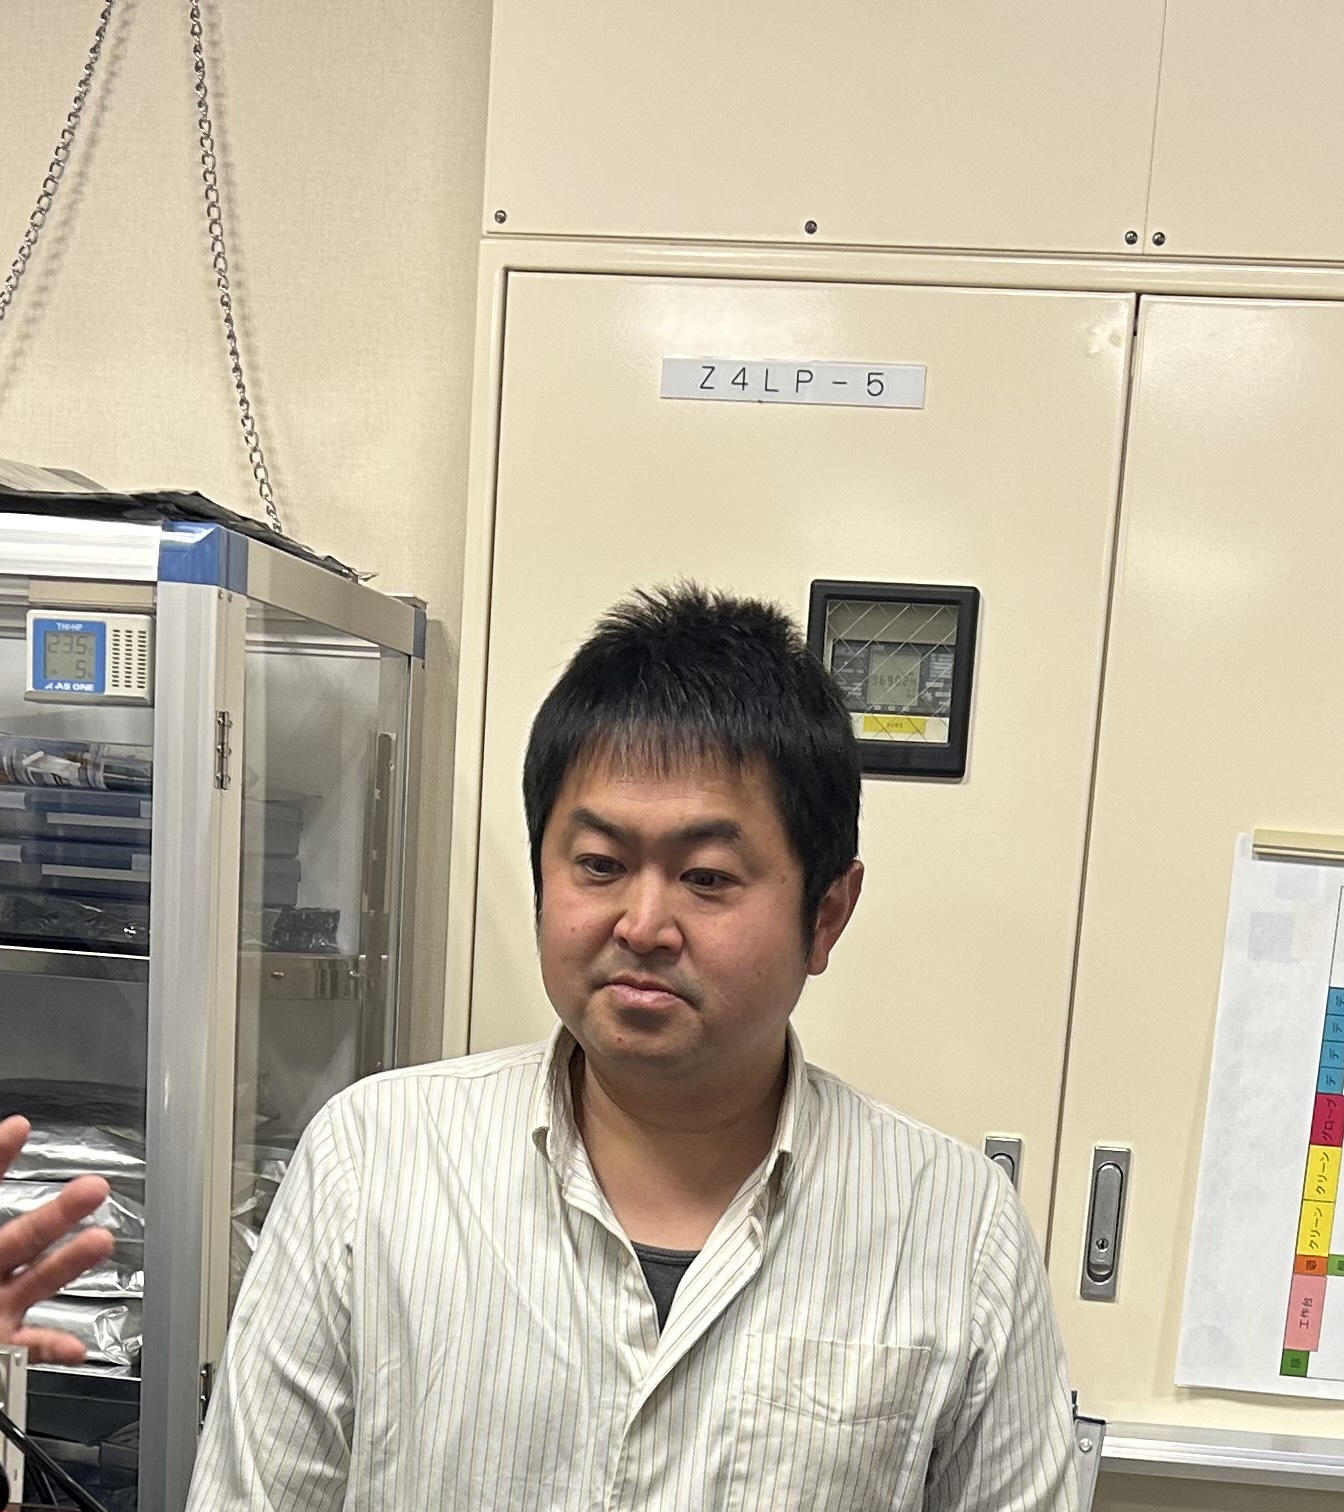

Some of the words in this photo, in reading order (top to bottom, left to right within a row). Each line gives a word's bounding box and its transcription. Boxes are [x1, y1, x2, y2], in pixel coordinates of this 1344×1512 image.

[699, 365, 885, 397] Z4LP-5
[55, 682, 71, 691] AS
[72, 683, 95, 692] ONE
[1316, 1151, 1330, 1195] クリーン
[1308, 1206, 1323, 1250] クリーン
[1299, 1297, 1313, 1330] 工作台
